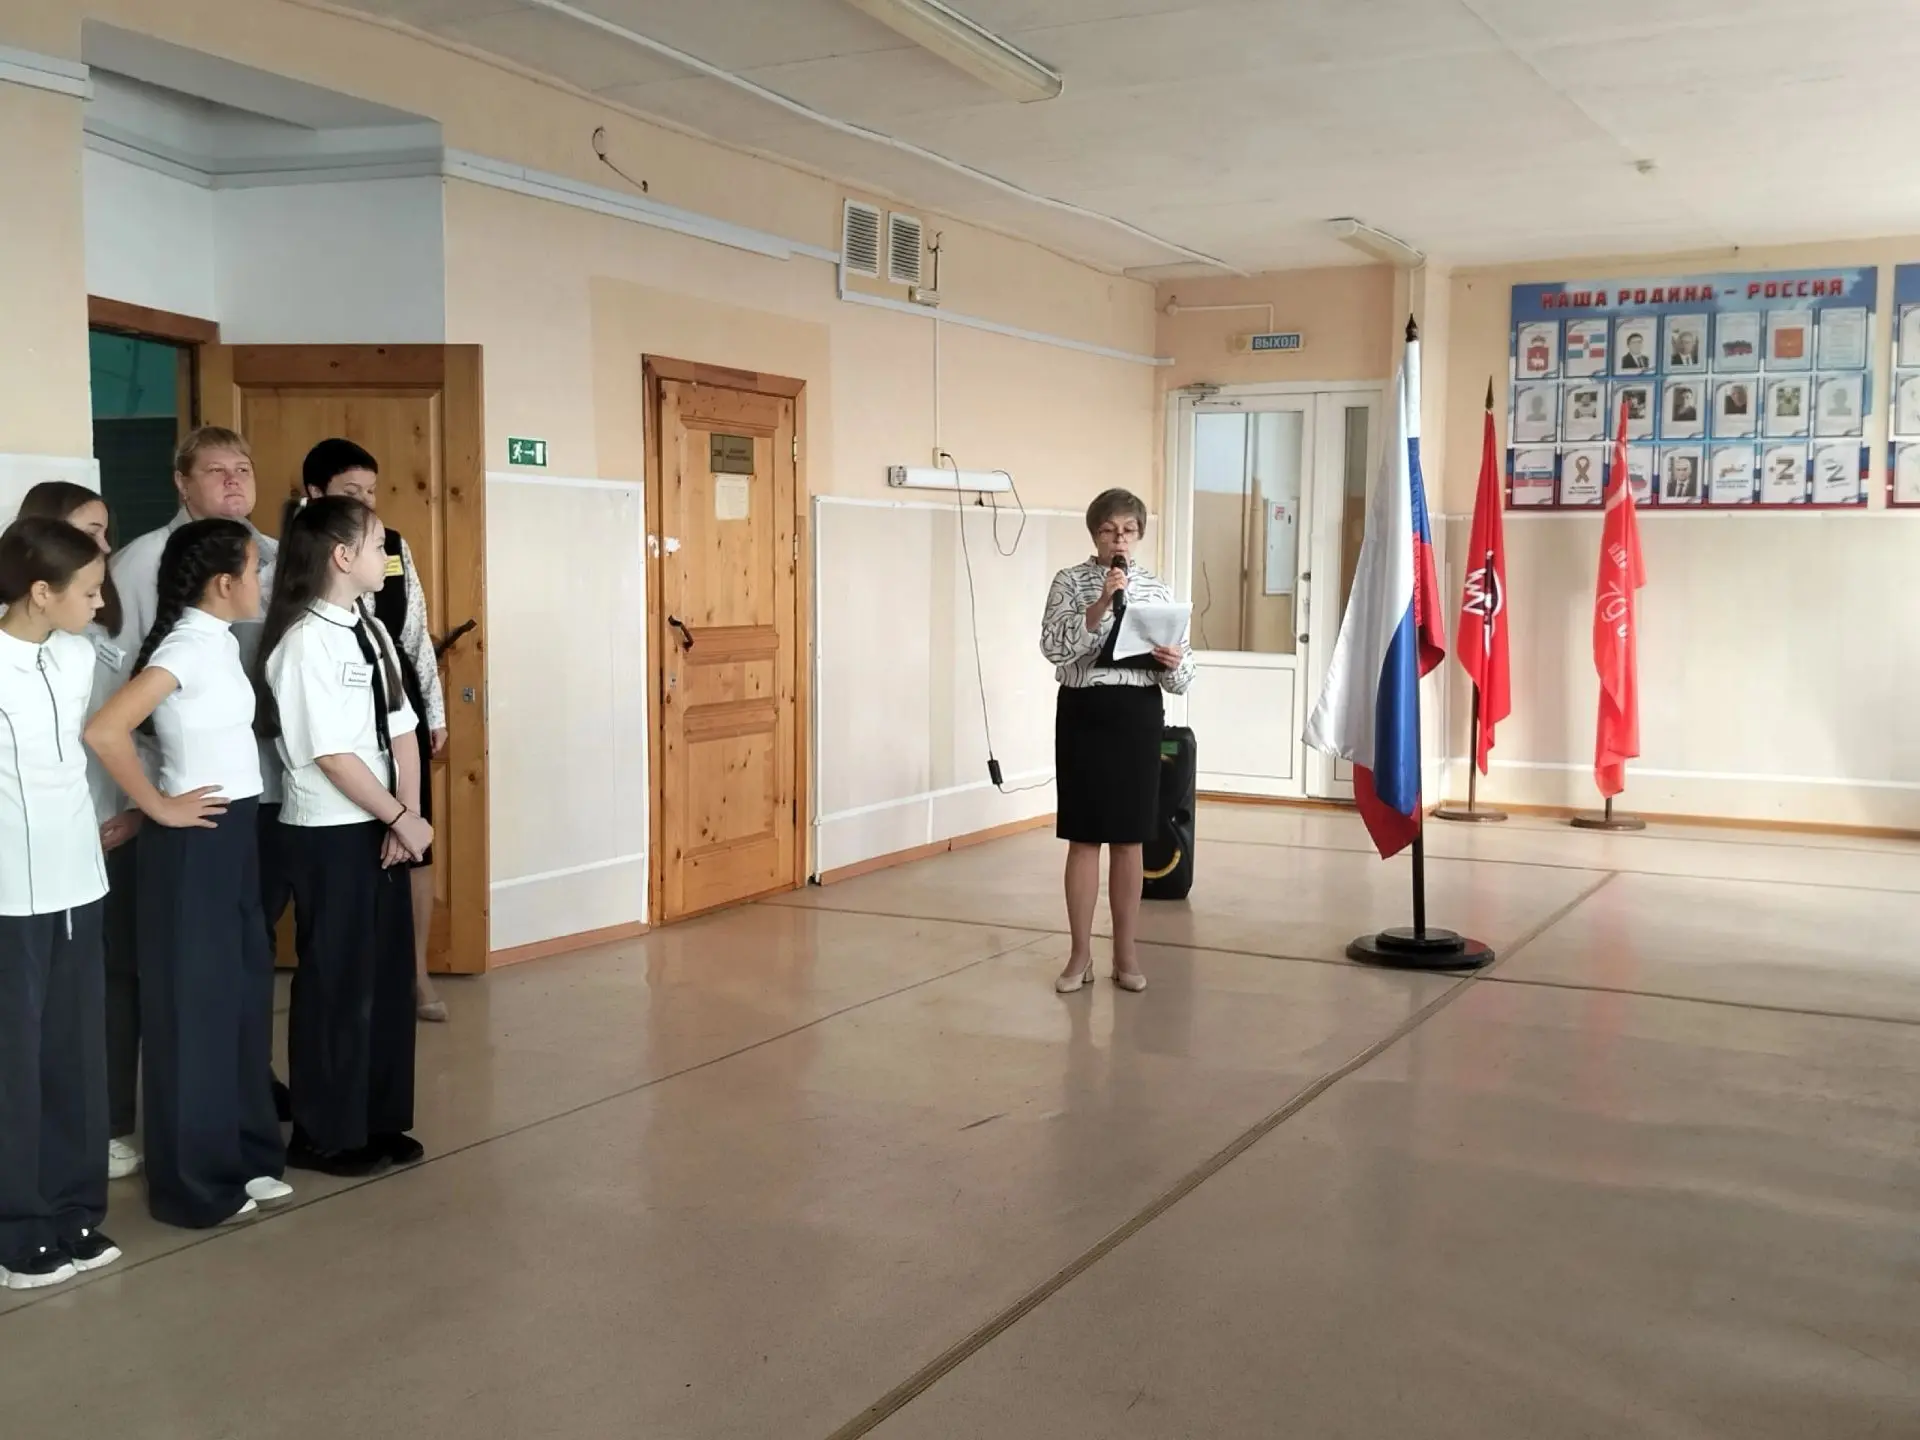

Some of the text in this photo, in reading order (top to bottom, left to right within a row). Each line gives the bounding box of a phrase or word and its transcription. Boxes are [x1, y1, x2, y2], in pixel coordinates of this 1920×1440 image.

[1541, 289, 1608, 309] НАША
[1618, 285, 1714, 306] РОДИНА
[1747, 278, 1844, 299] РОССИЯ
[1254, 336, 1298, 349] ВЫХОД
